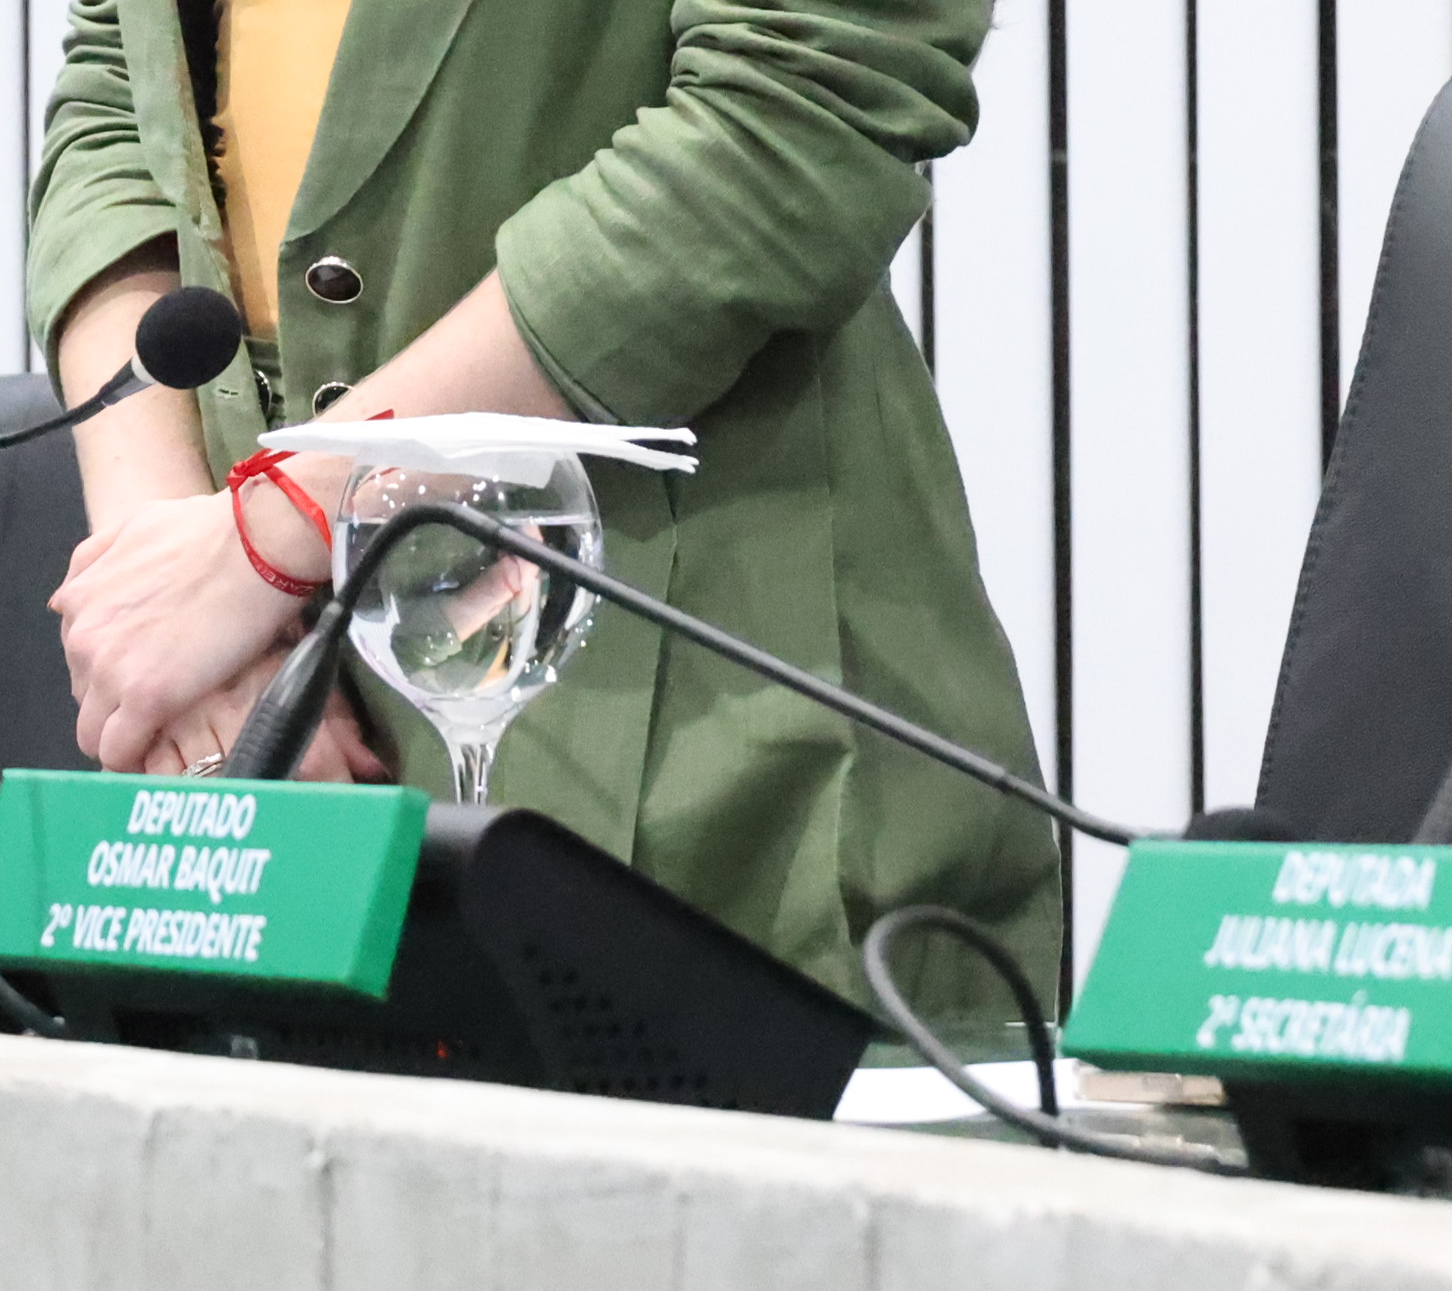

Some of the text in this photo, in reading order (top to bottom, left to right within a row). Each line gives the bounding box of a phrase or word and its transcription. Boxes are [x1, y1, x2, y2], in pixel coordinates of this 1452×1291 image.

[127, 790, 257, 841] DEPUTADO
[87, 840, 273, 905] OSMAR BAQUIT
[1272, 850, 1437, 910] DEPUTADA
[40, 903, 267, 962] 2º VICE PRESIDENTE
[1204, 915, 1338, 972] JULIANA
[1230, 989, 1411, 1063] SECRETÁRIA
